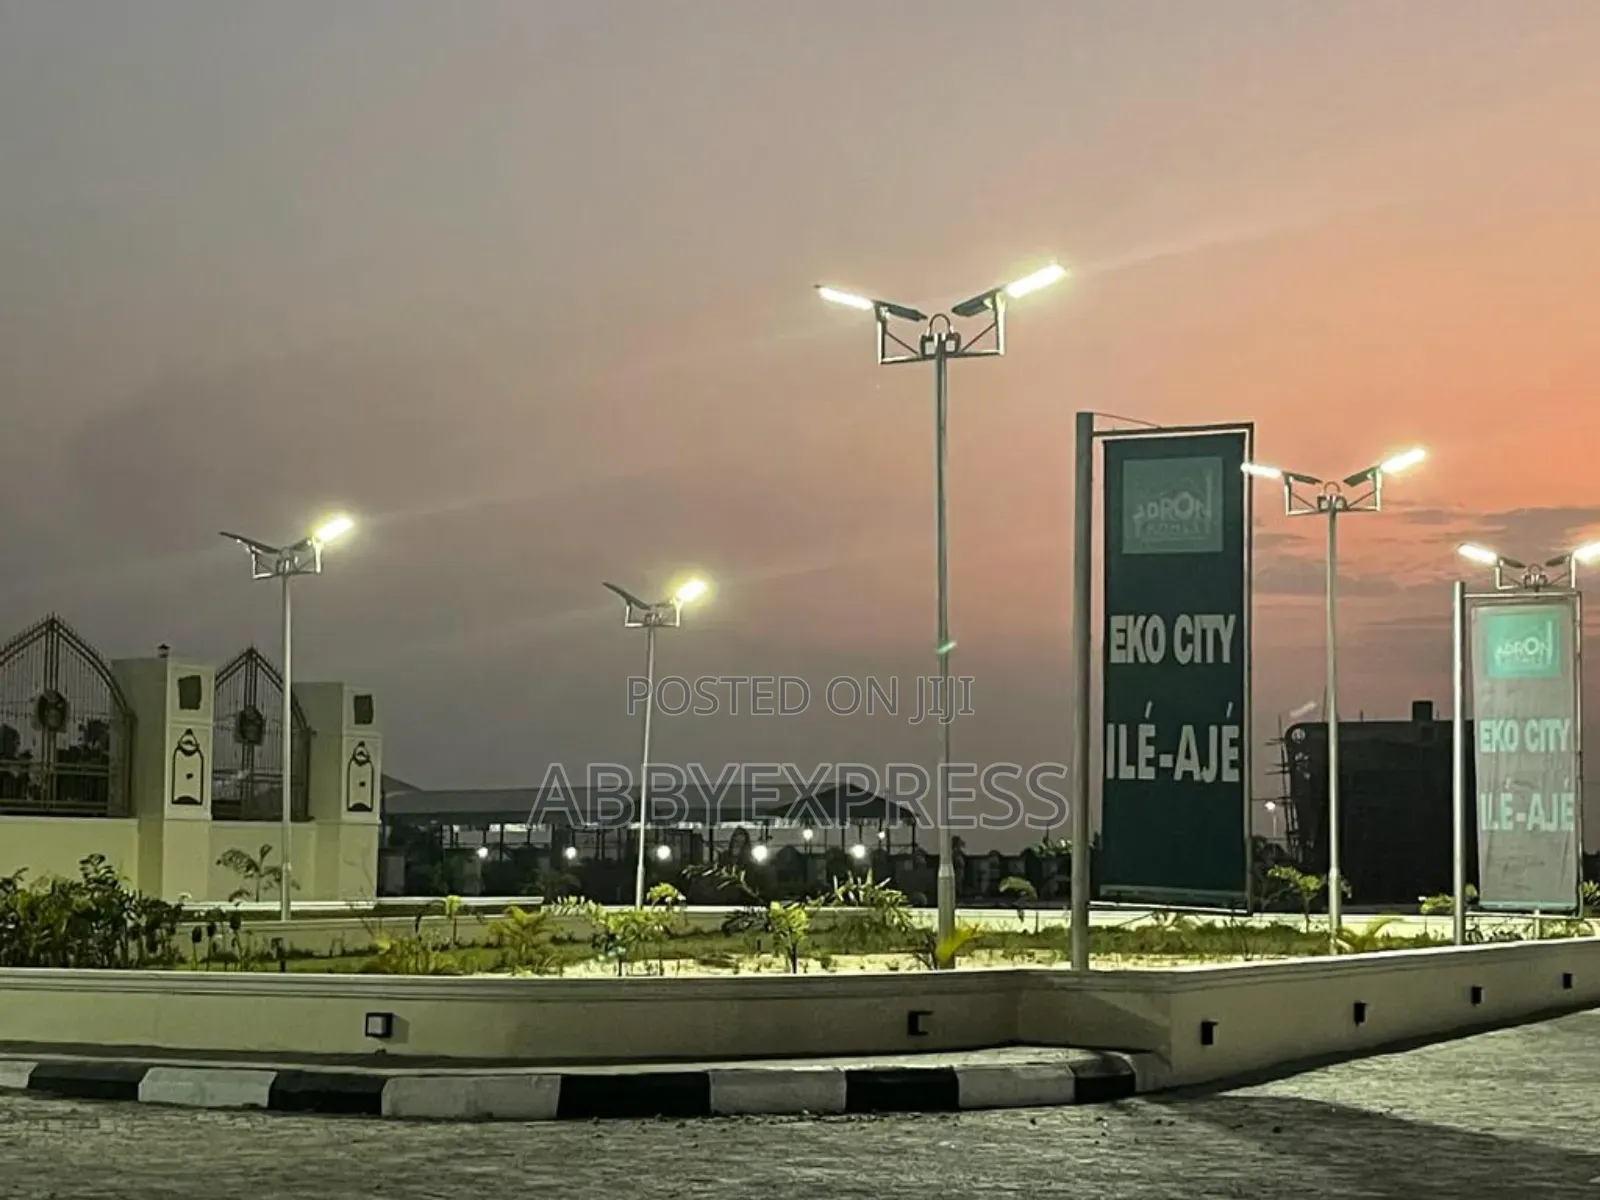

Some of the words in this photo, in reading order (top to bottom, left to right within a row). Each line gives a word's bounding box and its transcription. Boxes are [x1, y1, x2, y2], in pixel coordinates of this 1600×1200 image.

[1110, 614, 1166, 664] EKO
[1173, 613, 1237, 665] CITY
[1106, 701, 1240, 783] ILÉ-AJÉ
[1480, 718, 1520, 752] EKO
[1524, 717, 1571, 752] CITY
